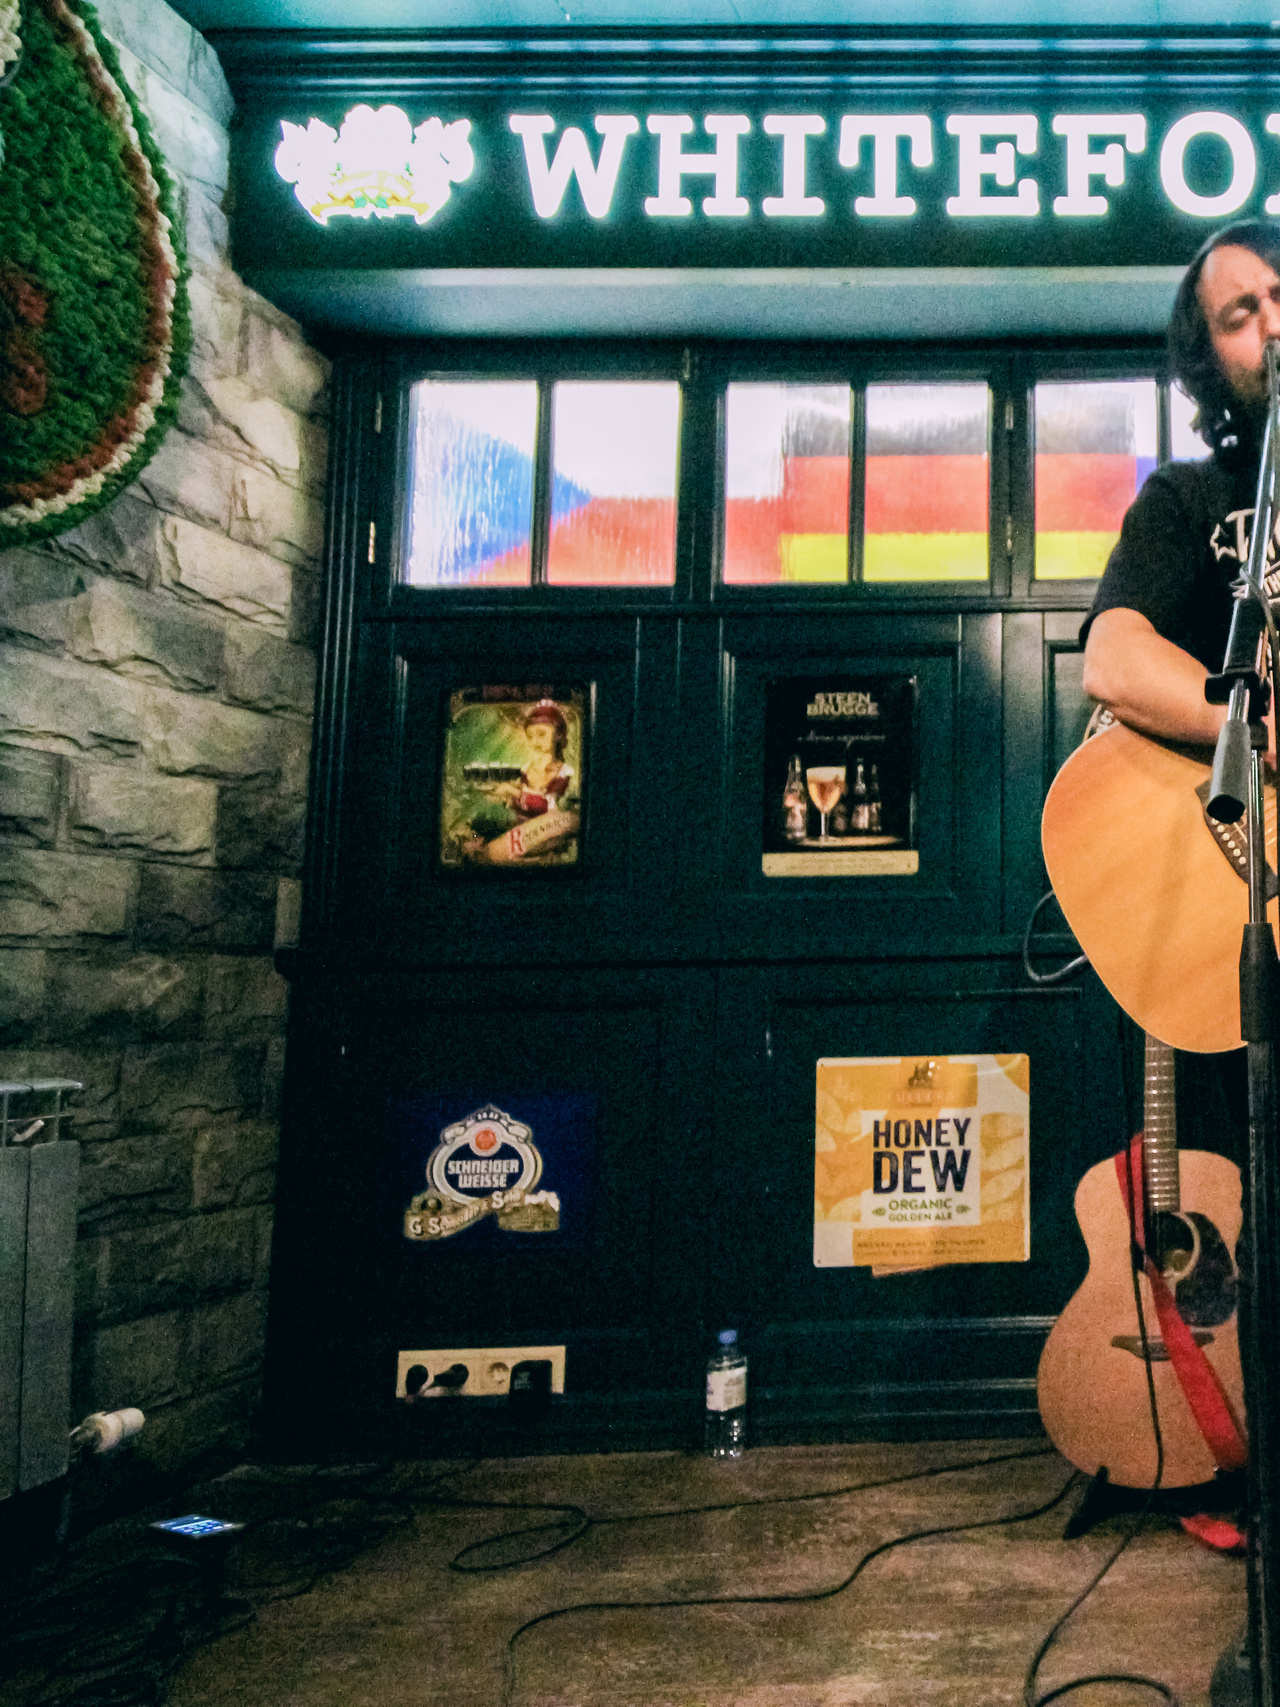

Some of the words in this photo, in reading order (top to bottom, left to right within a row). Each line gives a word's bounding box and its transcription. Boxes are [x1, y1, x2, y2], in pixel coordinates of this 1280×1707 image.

[815, 692, 871, 703] STEEN
[807, 703, 879, 716] BRUGGE
[873, 1118, 971, 1149] HONEY
[448, 1159, 519, 1175] SCHNEIDER
[873, 1149, 971, 1195] DEW
[458, 1174, 507, 1189] WEISSE
[888, 1198, 953, 1212] ORGANIC
[888, 1212, 932, 1223] GOLDEN
[934, 1212, 953, 1221] ALE
